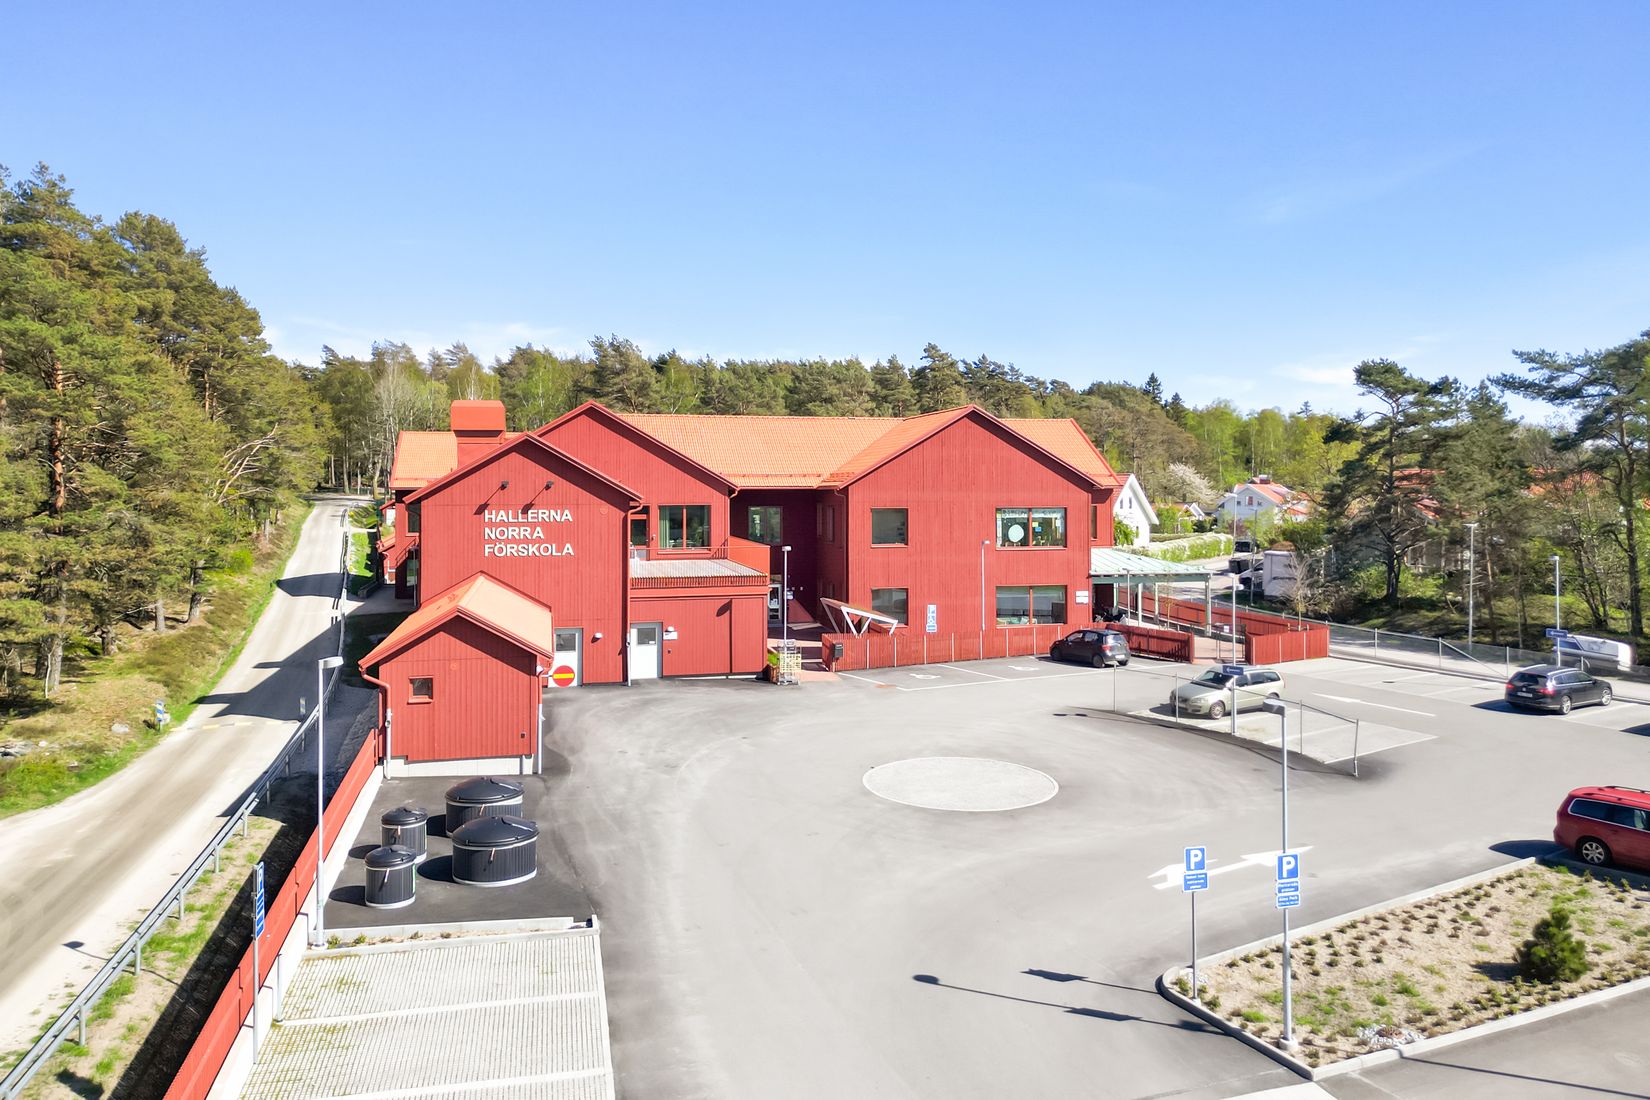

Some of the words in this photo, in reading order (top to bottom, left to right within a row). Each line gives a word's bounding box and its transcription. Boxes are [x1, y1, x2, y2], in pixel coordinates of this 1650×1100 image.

[484, 510, 573, 522] HALLERNA
[484, 527, 544, 540] NORRA
[484, 542, 574, 557] FÖRSKOLA
[1190, 850, 1202, 870] P
[1282, 856, 1295, 878] P
